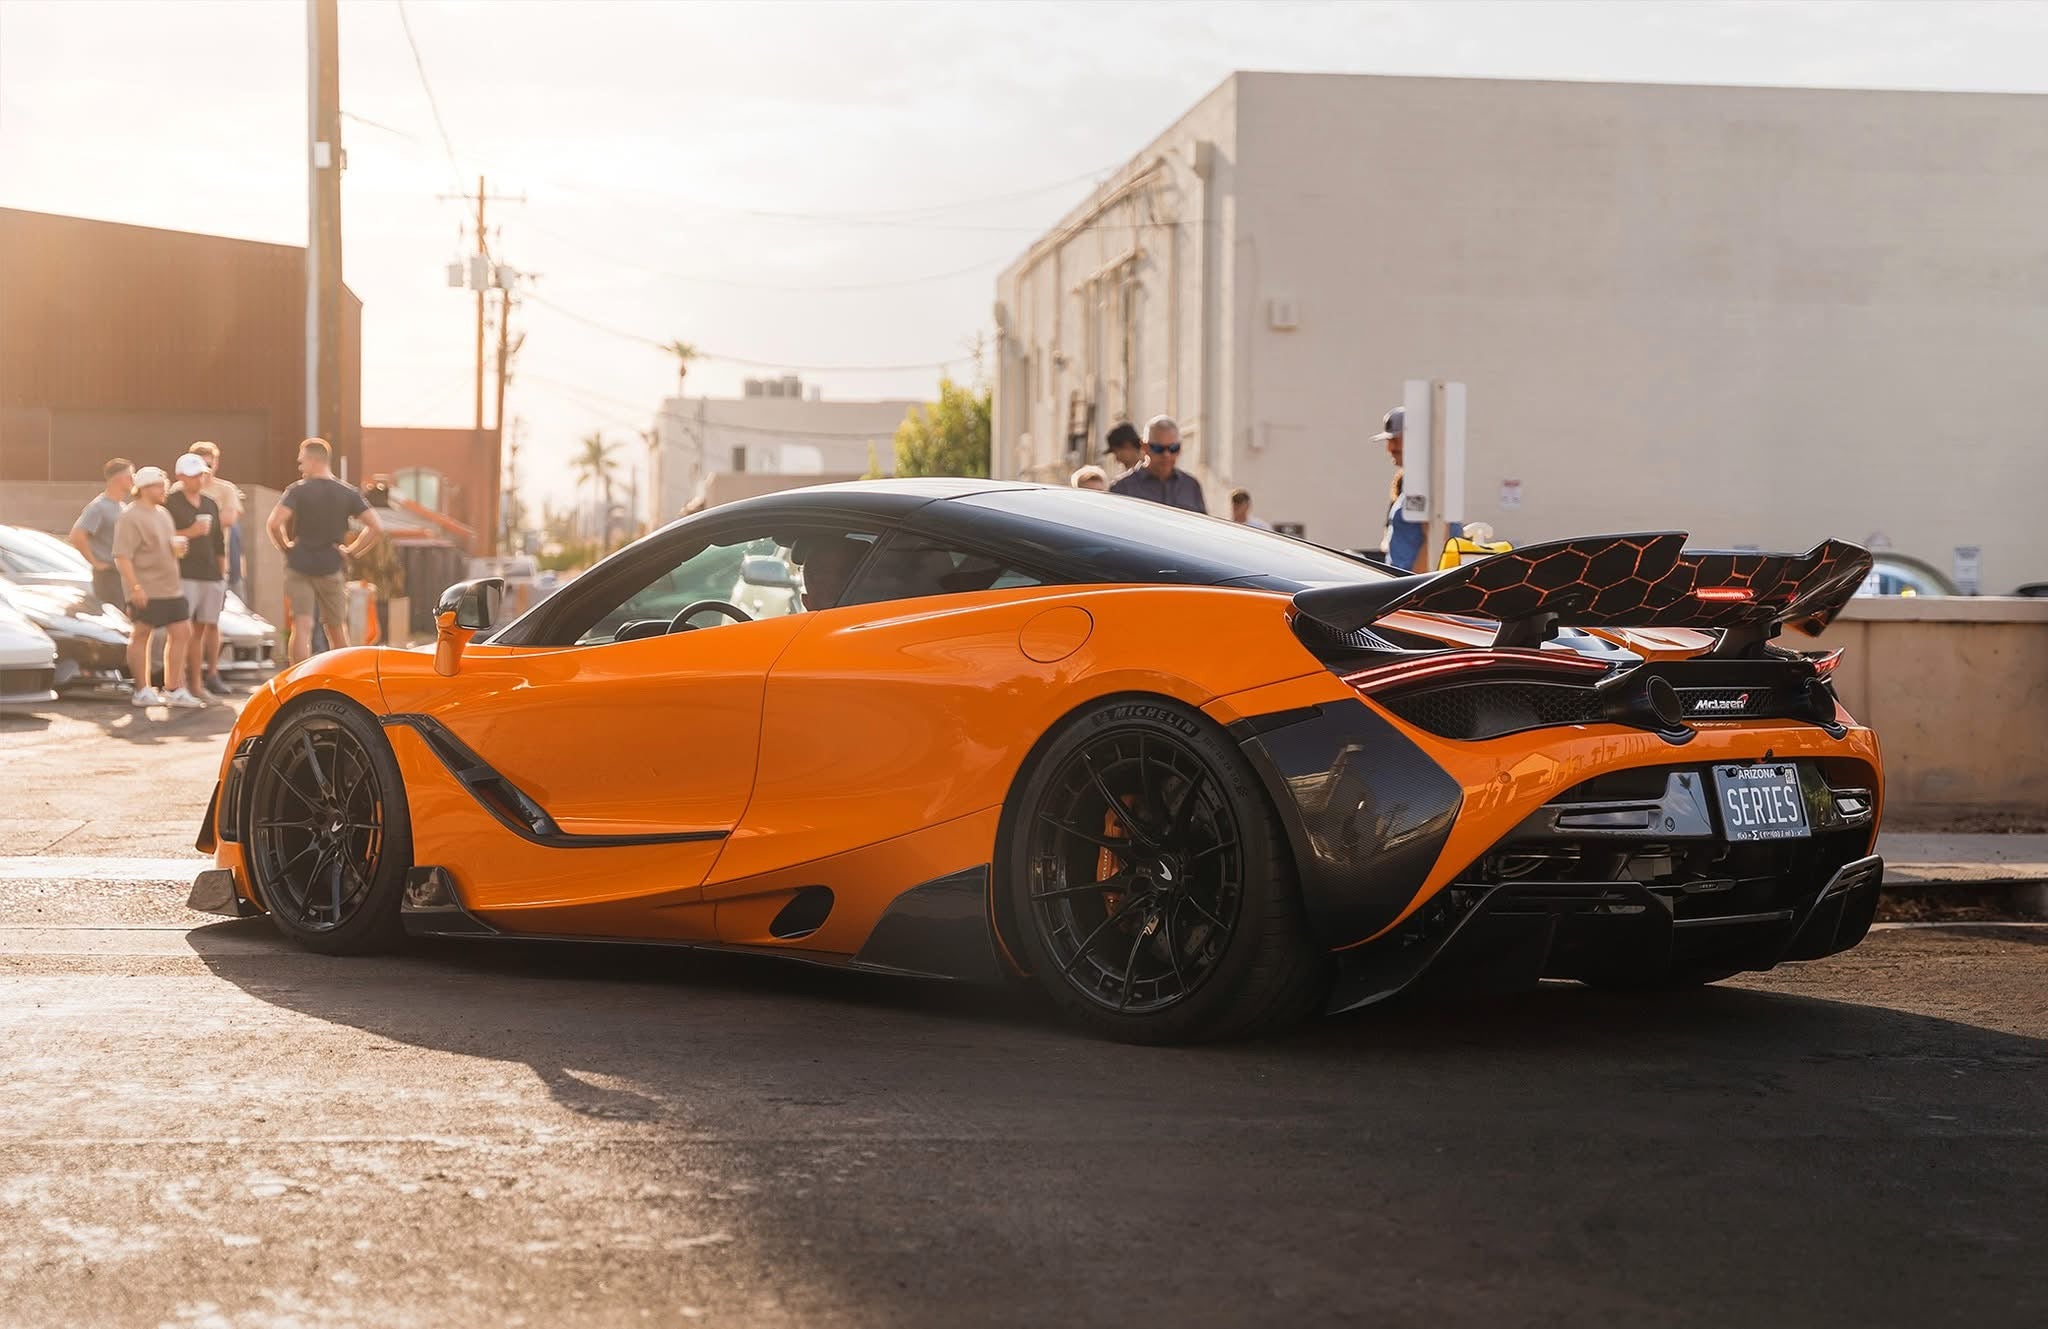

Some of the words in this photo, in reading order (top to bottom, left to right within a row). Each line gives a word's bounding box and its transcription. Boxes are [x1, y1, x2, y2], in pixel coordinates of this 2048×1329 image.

[1695, 699, 1744, 710] McLaren
[1114, 705, 1195, 734] MICHELIN
[1738, 768, 1777, 780] ARIZONA
[1727, 785, 1798, 825] SERIES
